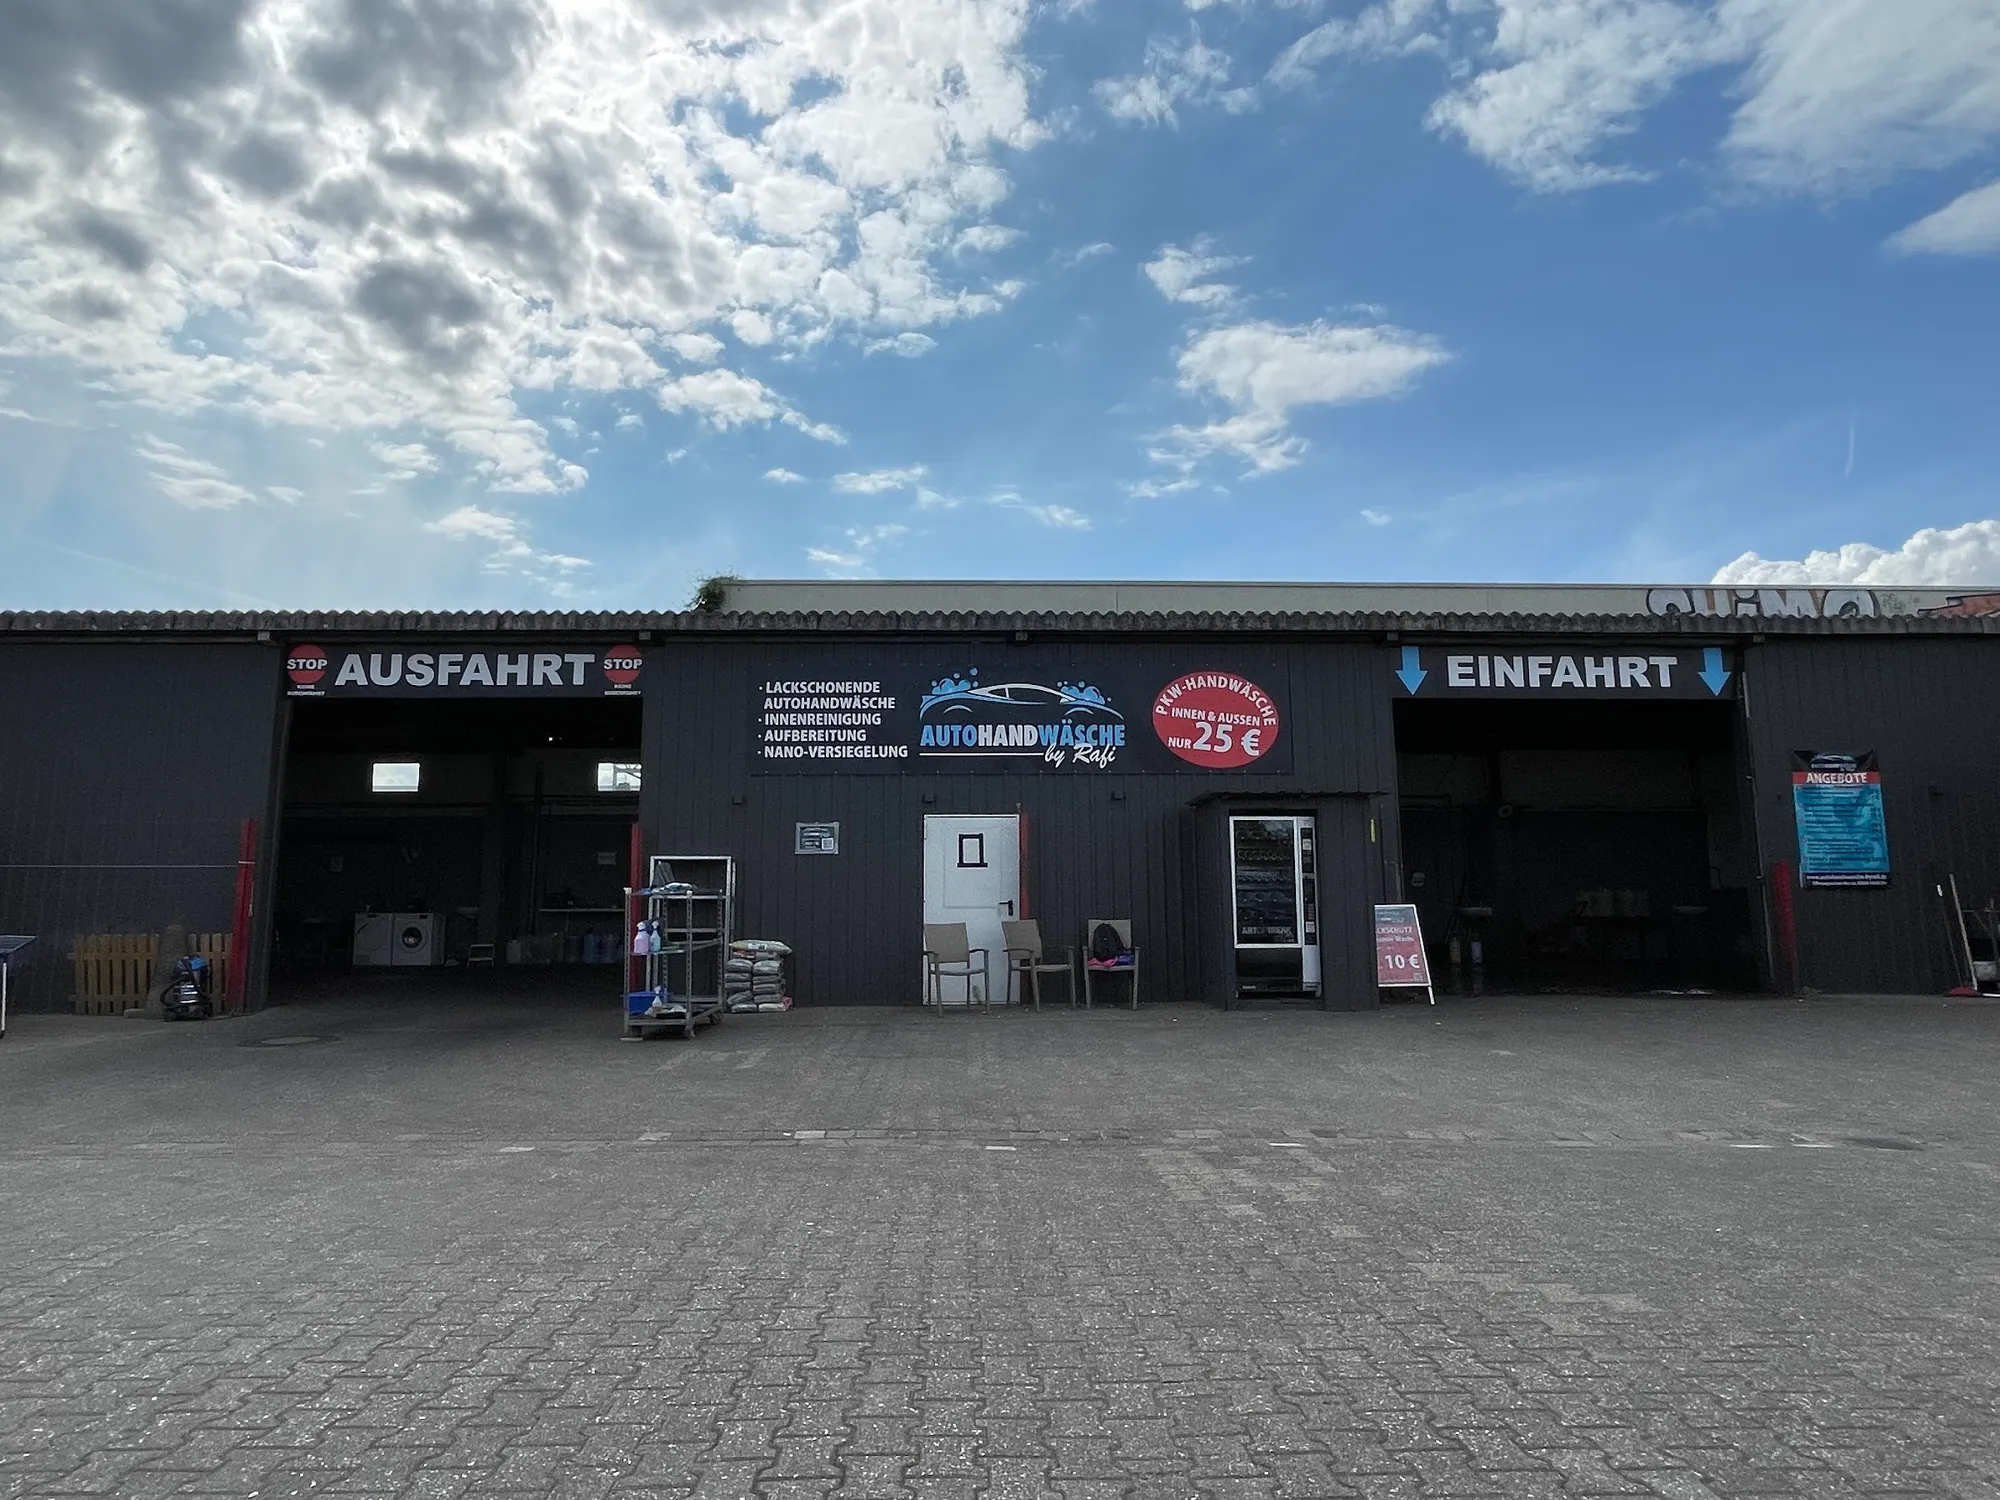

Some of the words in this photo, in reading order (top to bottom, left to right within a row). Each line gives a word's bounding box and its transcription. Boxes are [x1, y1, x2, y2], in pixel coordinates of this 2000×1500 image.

[287, 659, 328, 670] STOP
[334, 653, 595, 686] AUSFAHRT
[604, 659, 643, 670] STOP
[1447, 655, 1678, 688] EINFAHRT
[766, 681, 880, 693] LACKSCHONENDE
[764, 695, 896, 709] AUTOHANDWÄSCHE
[1155, 675, 1276, 726] PKW-HANDWÄSCHE
[764, 713, 882, 725] INNENREINIGUNG
[1171, 707, 1206, 720] INNEN
[1207, 711, 1216, 721] &
[1217, 712, 1260, 726] AUSSEN
[764, 729, 867, 742] AUFBEREITUNG
[920, 719, 1126, 747] AUTOHANDWÄSCHE
[1168, 737, 1192, 749] NUR
[1193, 721, 1233, 753] 25
[1241, 728, 1261, 756] €
[764, 745, 908, 758] NANO-VERSIEGELUNG
[1044, 742, 1065, 768] by
[1072, 743, 1117, 769] Rafi
[1806, 772, 1868, 784] ANGEBOTE
[1384, 954, 1405, 969] 10
[1408, 953, 1420, 969] €
